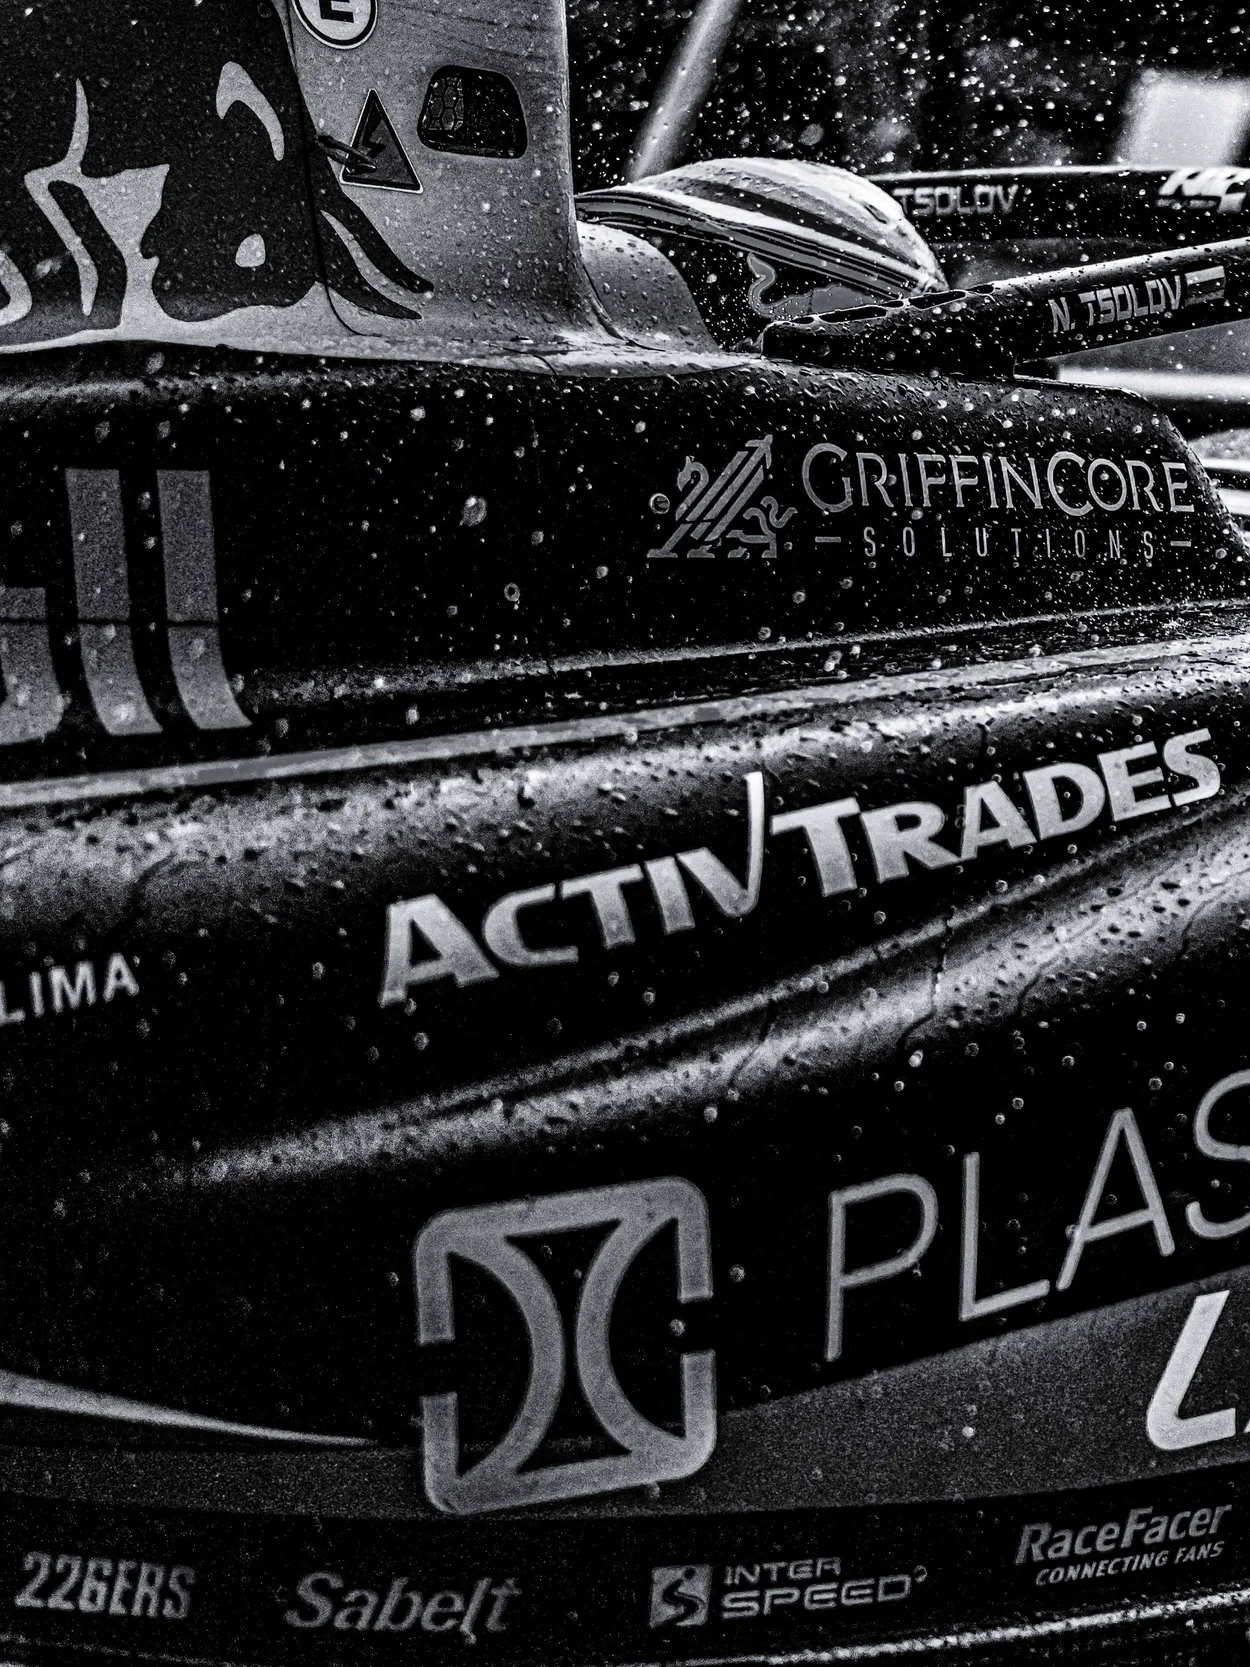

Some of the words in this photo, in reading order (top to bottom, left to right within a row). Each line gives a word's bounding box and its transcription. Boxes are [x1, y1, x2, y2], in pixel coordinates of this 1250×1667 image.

[893, 185, 1018, 215] TSOLOV
[1048, 297, 1076, 333] N.
[1079, 275, 1181, 327] TSOLOV
[864, 526, 1155, 559] SOLUTIONS
[1015, 1504, 1233, 1566] RaceFacer
[14, 1550, 196, 1619] 226ERS
[724, 1556, 842, 1585] INTER
[1035, 1549, 1169, 1587] CONNECTING
[1174, 1540, 1225, 1564] FANS
[284, 1571, 522, 1645] Sabelt
